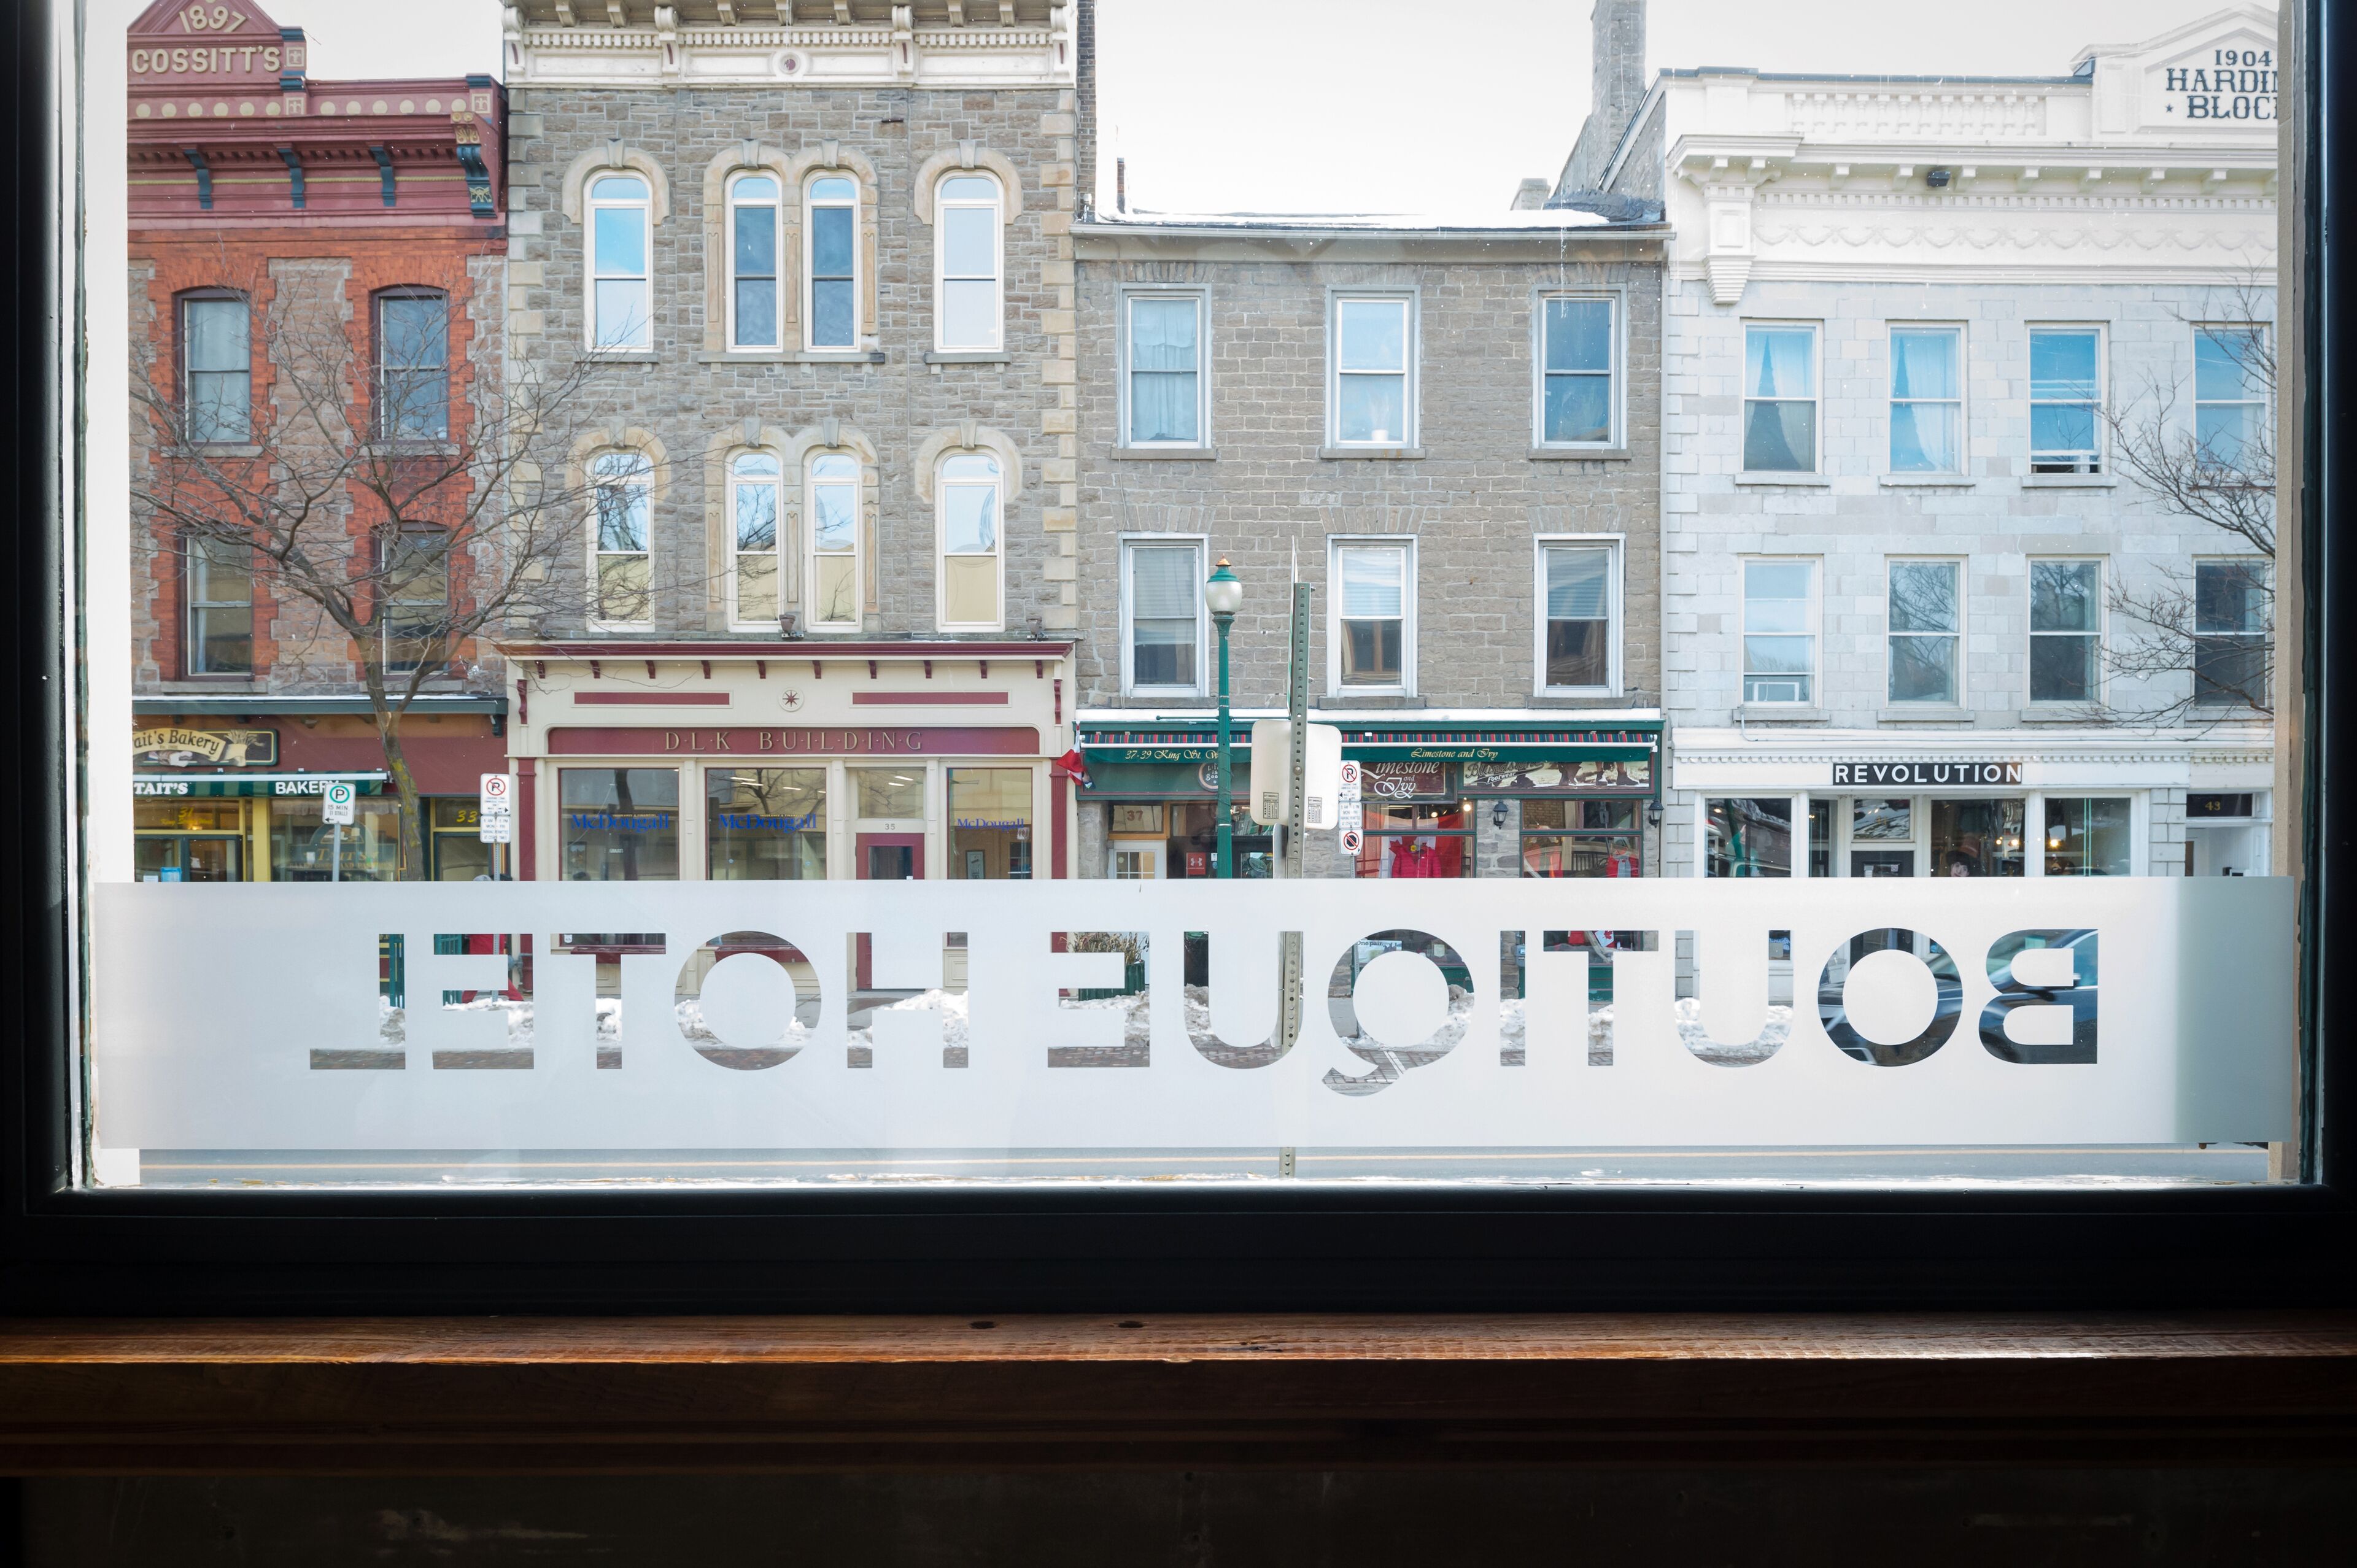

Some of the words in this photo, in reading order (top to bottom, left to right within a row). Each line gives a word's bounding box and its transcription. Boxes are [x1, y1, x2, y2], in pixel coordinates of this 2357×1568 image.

[179, 6, 247, 33] 1897
[131, 46, 281, 74] COSSITT'S
[2215, 50, 2272, 67] 1904
[2187, 96, 2278, 119] BLOC
[133, 730, 164, 748] ait's
[168, 730, 220, 754] Bakery
[1125, 749, 1152, 759] 37-39
[1154, 749, 1181, 761] King
[1183, 749, 1201, 759] St.
[1411, 747, 1456, 758] Limestone
[1457, 749, 1475, 757] and
[1477, 748, 1498, 761] Ivy
[1487, 772, 1516, 784] Footwear
[1835, 765, 2022, 782] REVOLUTION
[134, 782, 188, 795] TAIT'S
[276, 780, 339, 794] BAKER
[1374, 777, 1416, 798] Ivy
[2205, 801, 2221, 811] 43
[456, 810, 478, 822] 33
[571, 813, 668, 833] McDougall
[718, 813, 817, 833] McDougall
[1127, 810, 1144, 821] 37
[958, 818, 1024, 833] McDougall
